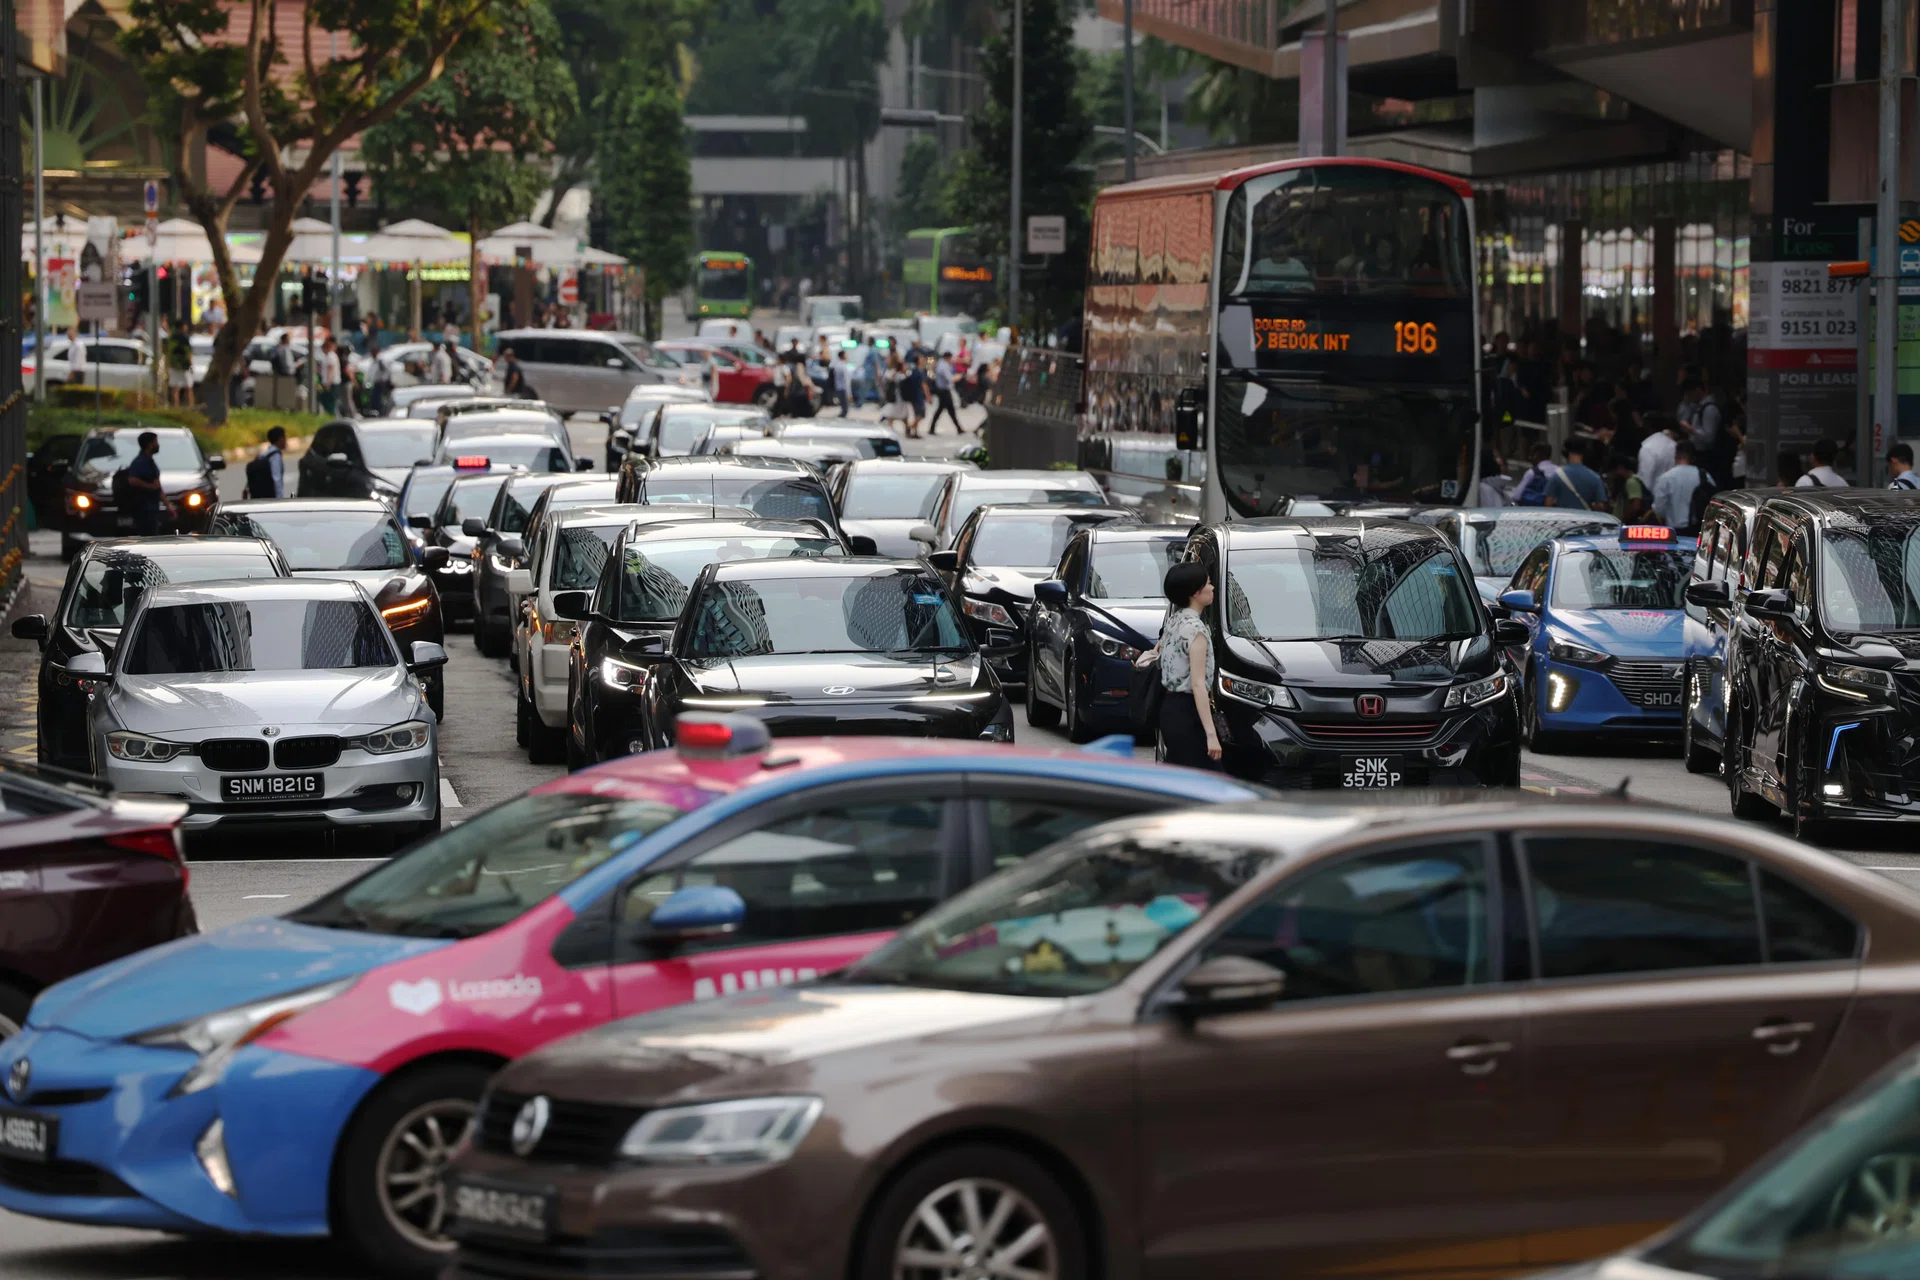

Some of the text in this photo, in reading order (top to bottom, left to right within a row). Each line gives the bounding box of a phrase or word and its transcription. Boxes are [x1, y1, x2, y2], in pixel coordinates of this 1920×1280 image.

[1782, 218, 1816, 235] For
[1783, 237, 1835, 255] Lease
[1782, 279, 1822, 294] 9821
[1254, 318, 1306, 332] DOVER RD
[1781, 320, 1822, 335] 9151
[1268, 332, 1350, 351] BEDOK INT
[1394, 321, 1437, 354] 196
[1779, 373, 1809, 385] FOR
[1627, 527, 1670, 539] HIRED
[1355, 758, 1389, 773] SNK
[448, 972, 543, 1002] Lazada
